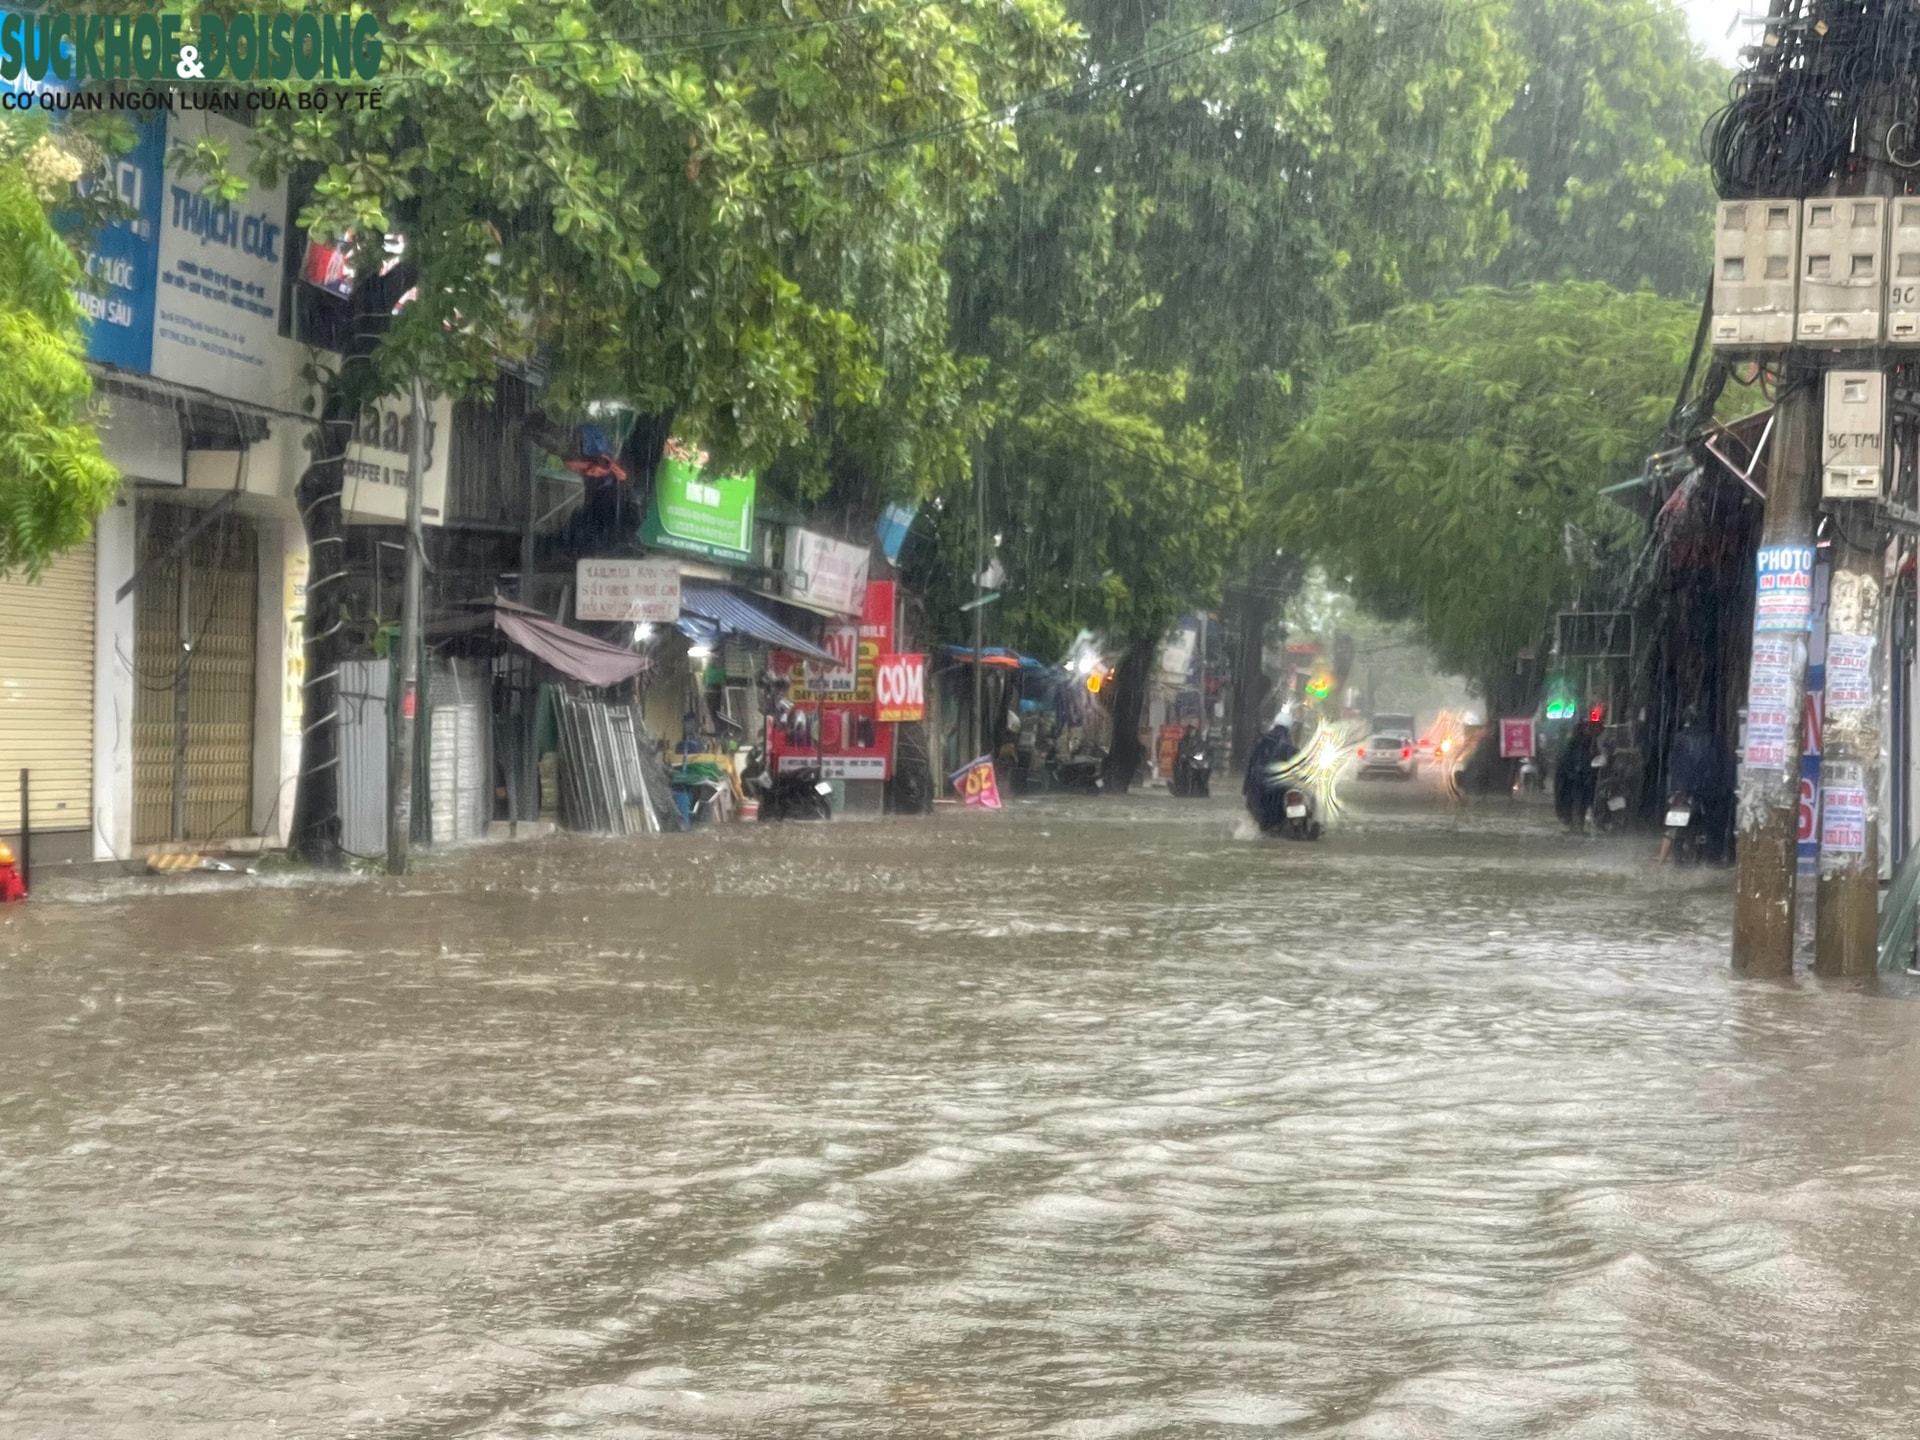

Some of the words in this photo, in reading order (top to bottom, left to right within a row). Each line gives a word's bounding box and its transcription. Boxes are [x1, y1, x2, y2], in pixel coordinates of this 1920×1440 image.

[1757, 548, 1812, 572] PHOTO
[1760, 575, 1774, 589] IN
[876, 657, 924, 704] CƠM
